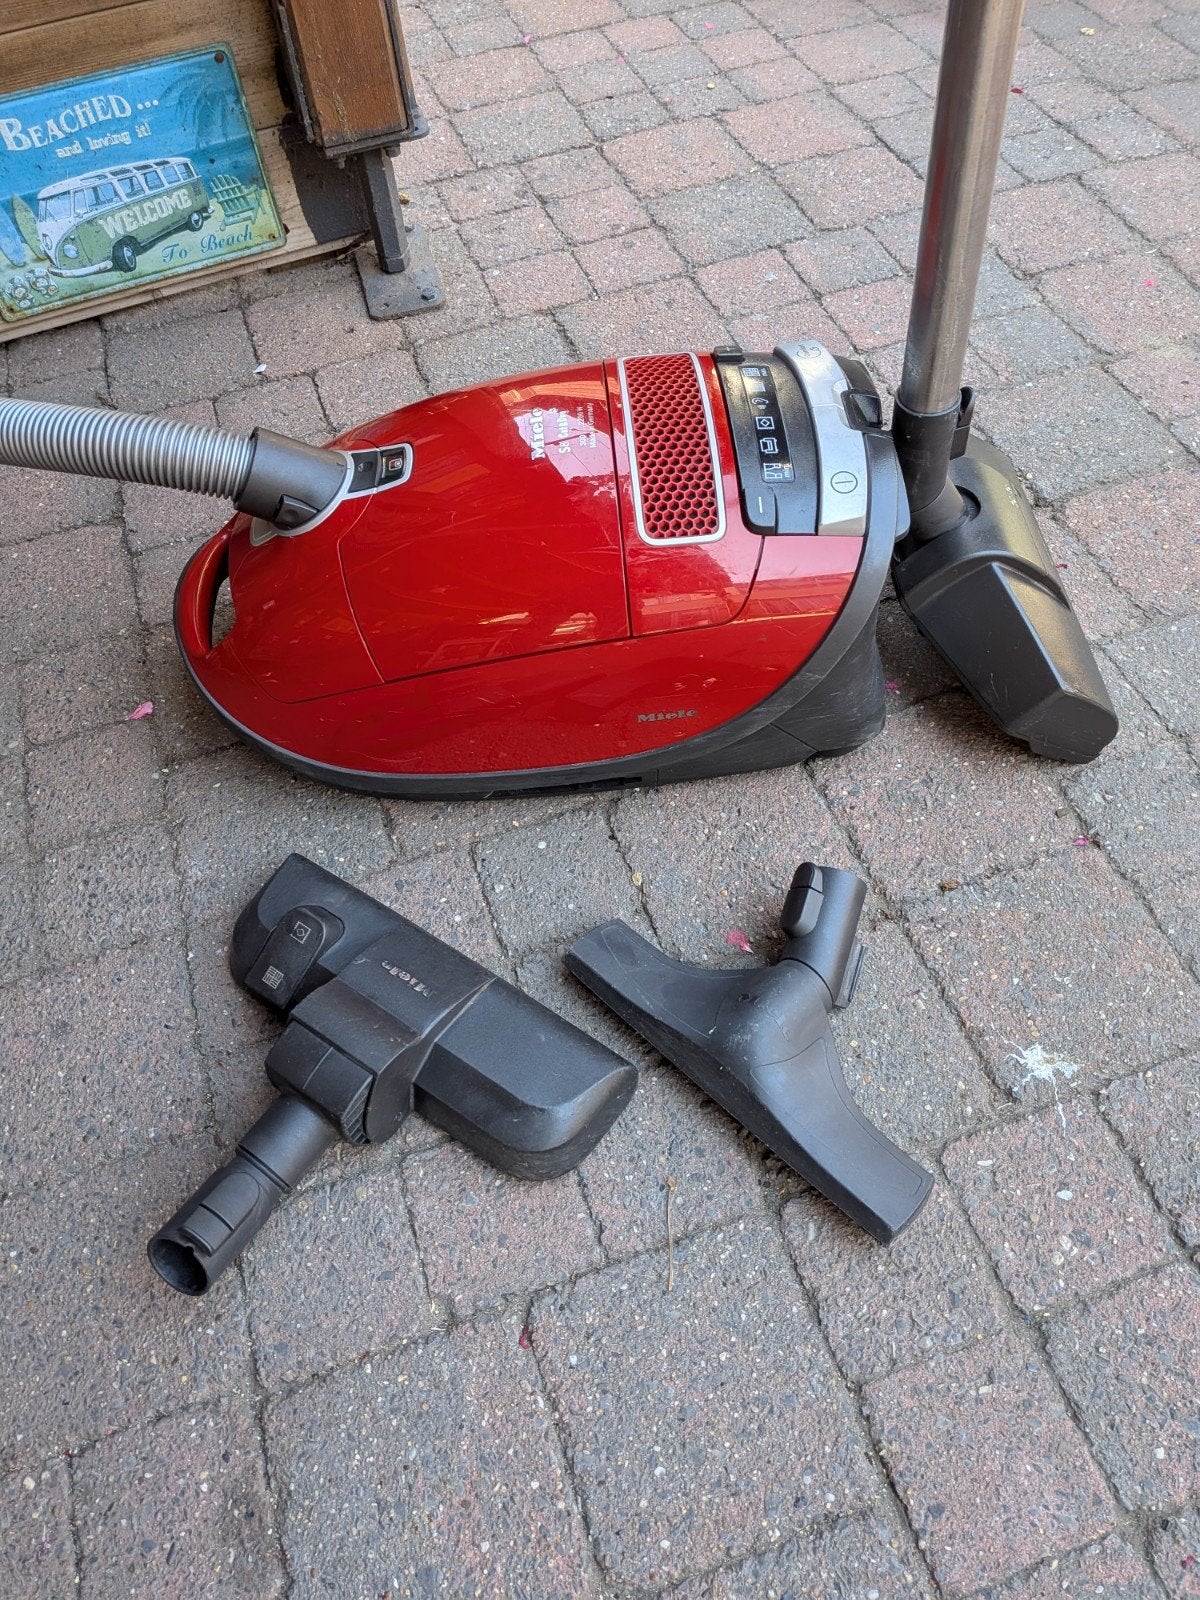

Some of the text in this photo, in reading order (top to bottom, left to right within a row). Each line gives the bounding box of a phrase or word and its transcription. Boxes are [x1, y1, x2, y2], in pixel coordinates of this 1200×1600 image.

[55, 122, 152, 159] and loving it!
[98, 188, 193, 239] WELCOME
[161, 224, 254, 264] To Beach
[529, 406, 546, 461] Miele
[589, 431, 597, 448] Made
[637, 709, 697, 723] Miele
[381, 959, 435, 999] Miele
